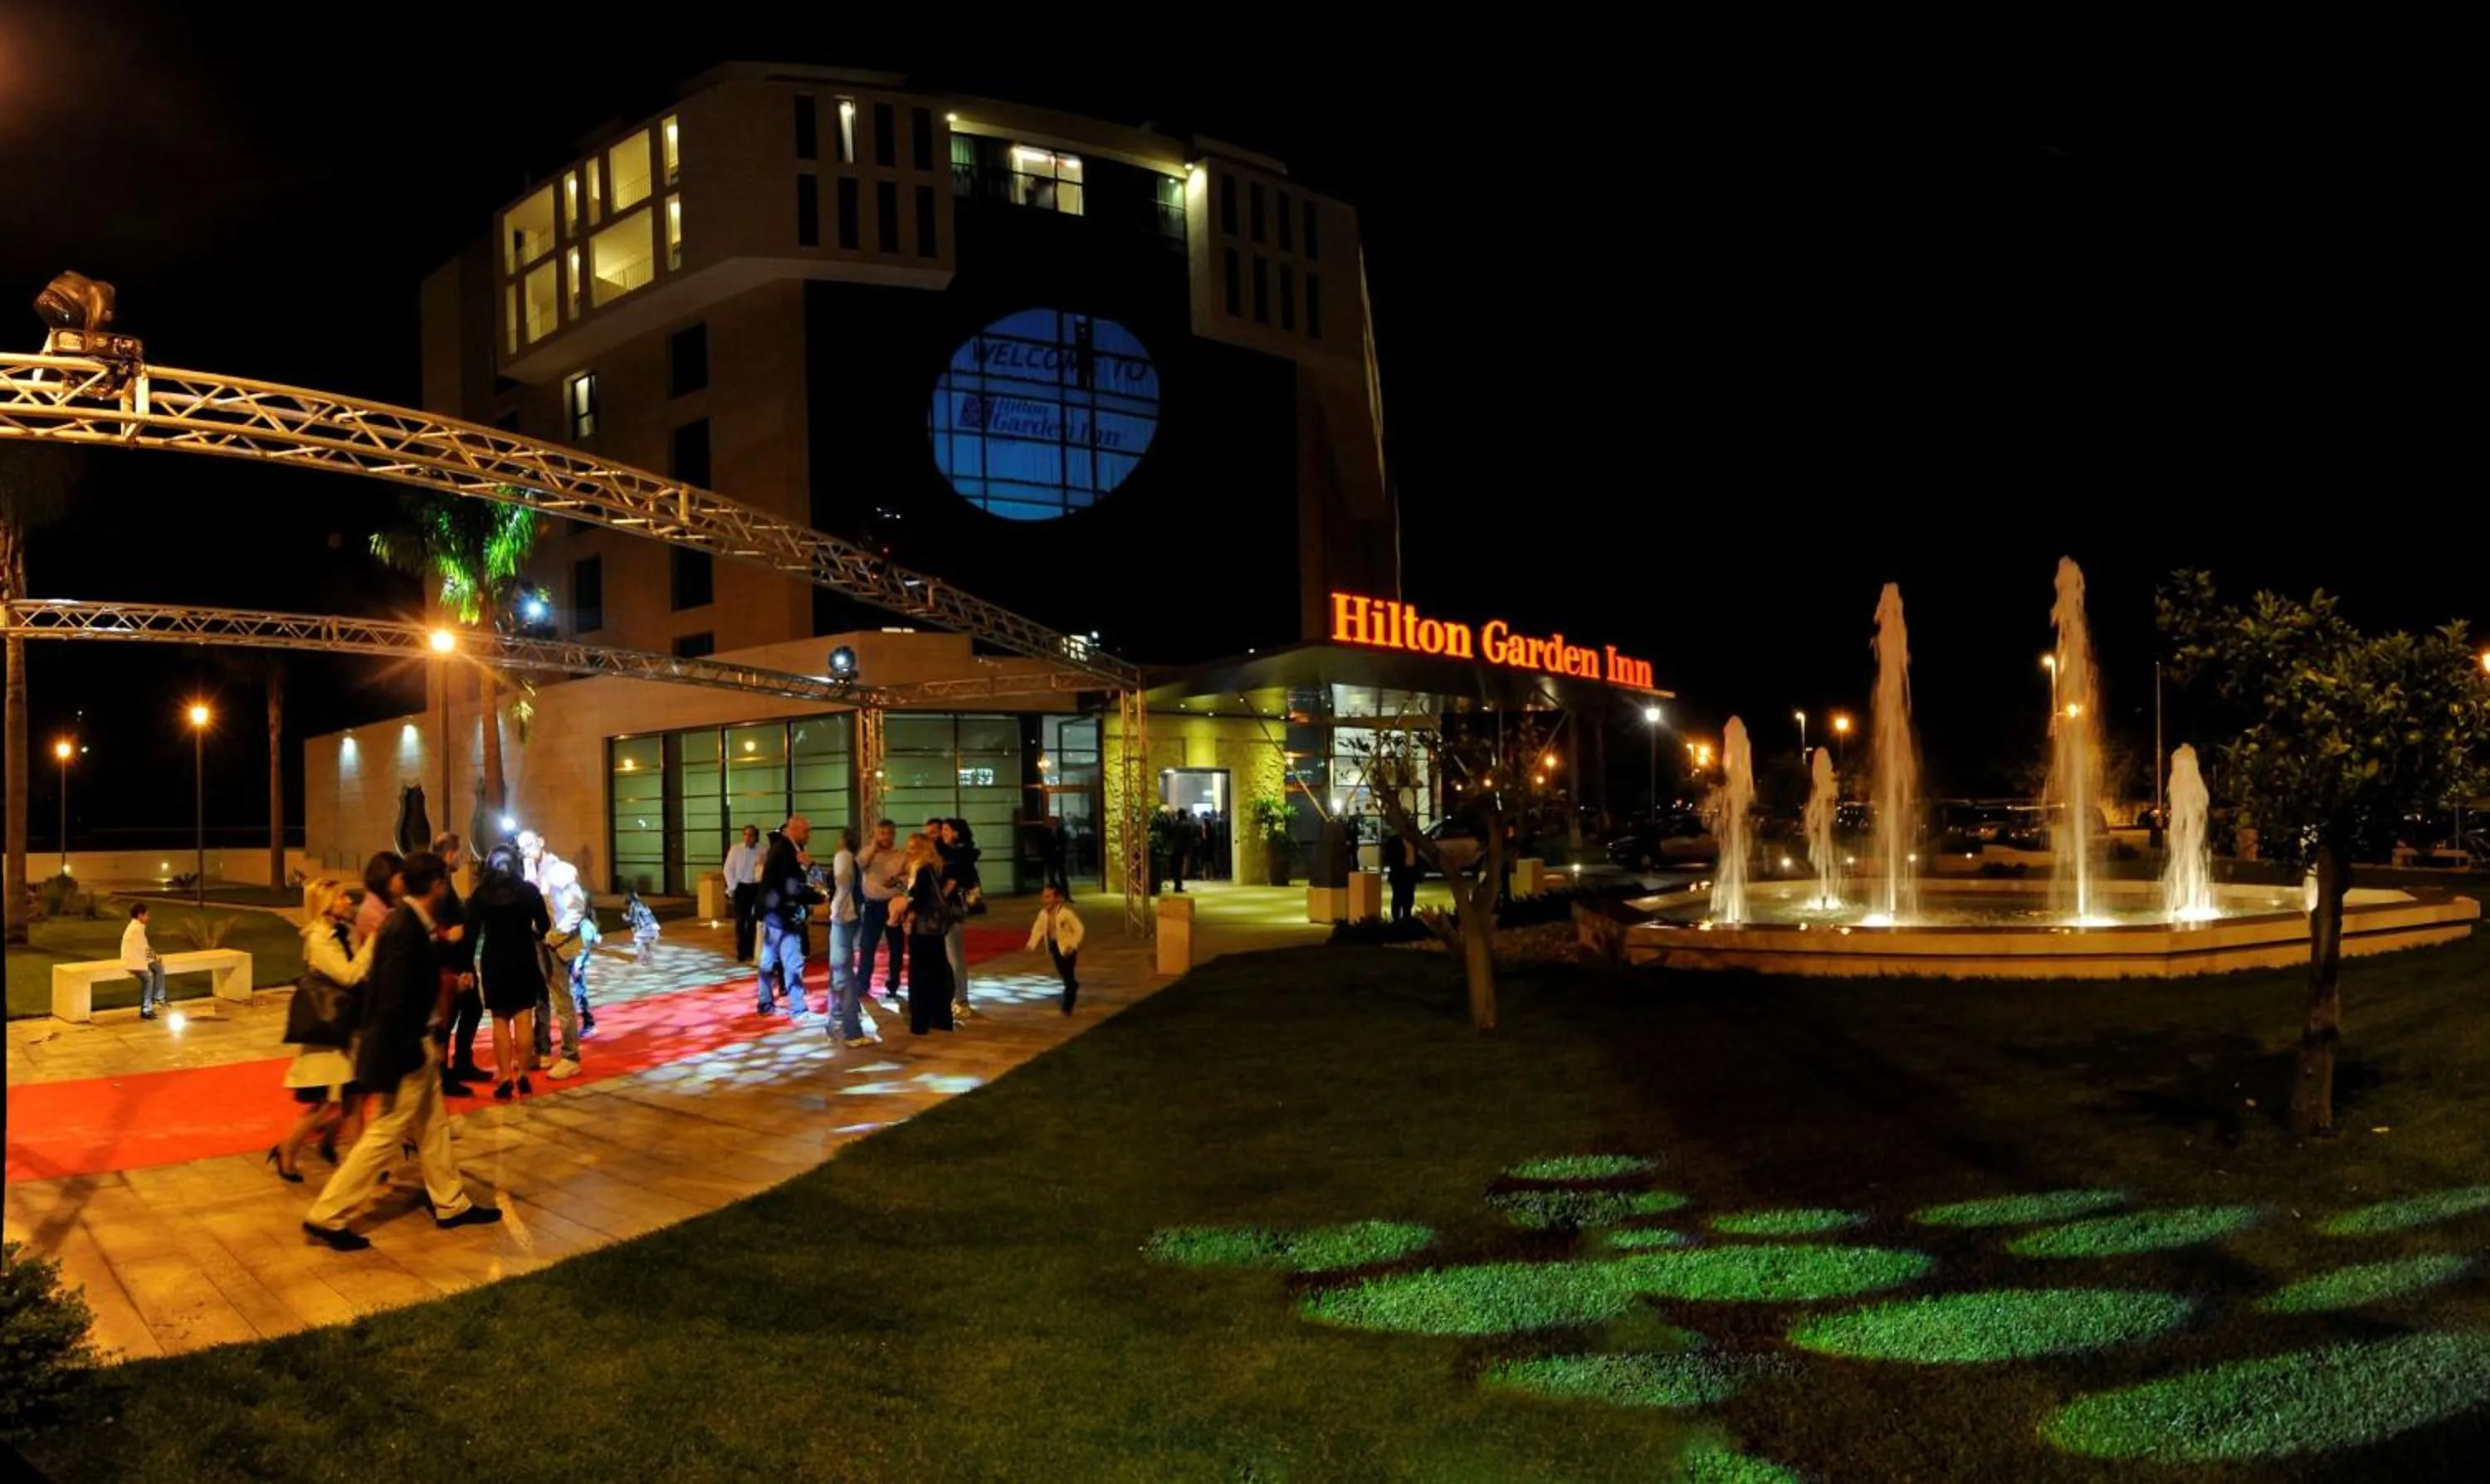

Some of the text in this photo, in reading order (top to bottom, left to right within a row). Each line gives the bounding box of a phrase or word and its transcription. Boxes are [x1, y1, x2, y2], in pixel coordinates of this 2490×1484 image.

[973, 340, 1096, 373] WELCOM
[1331, 592, 1653, 689] Hilton Garden Inn
